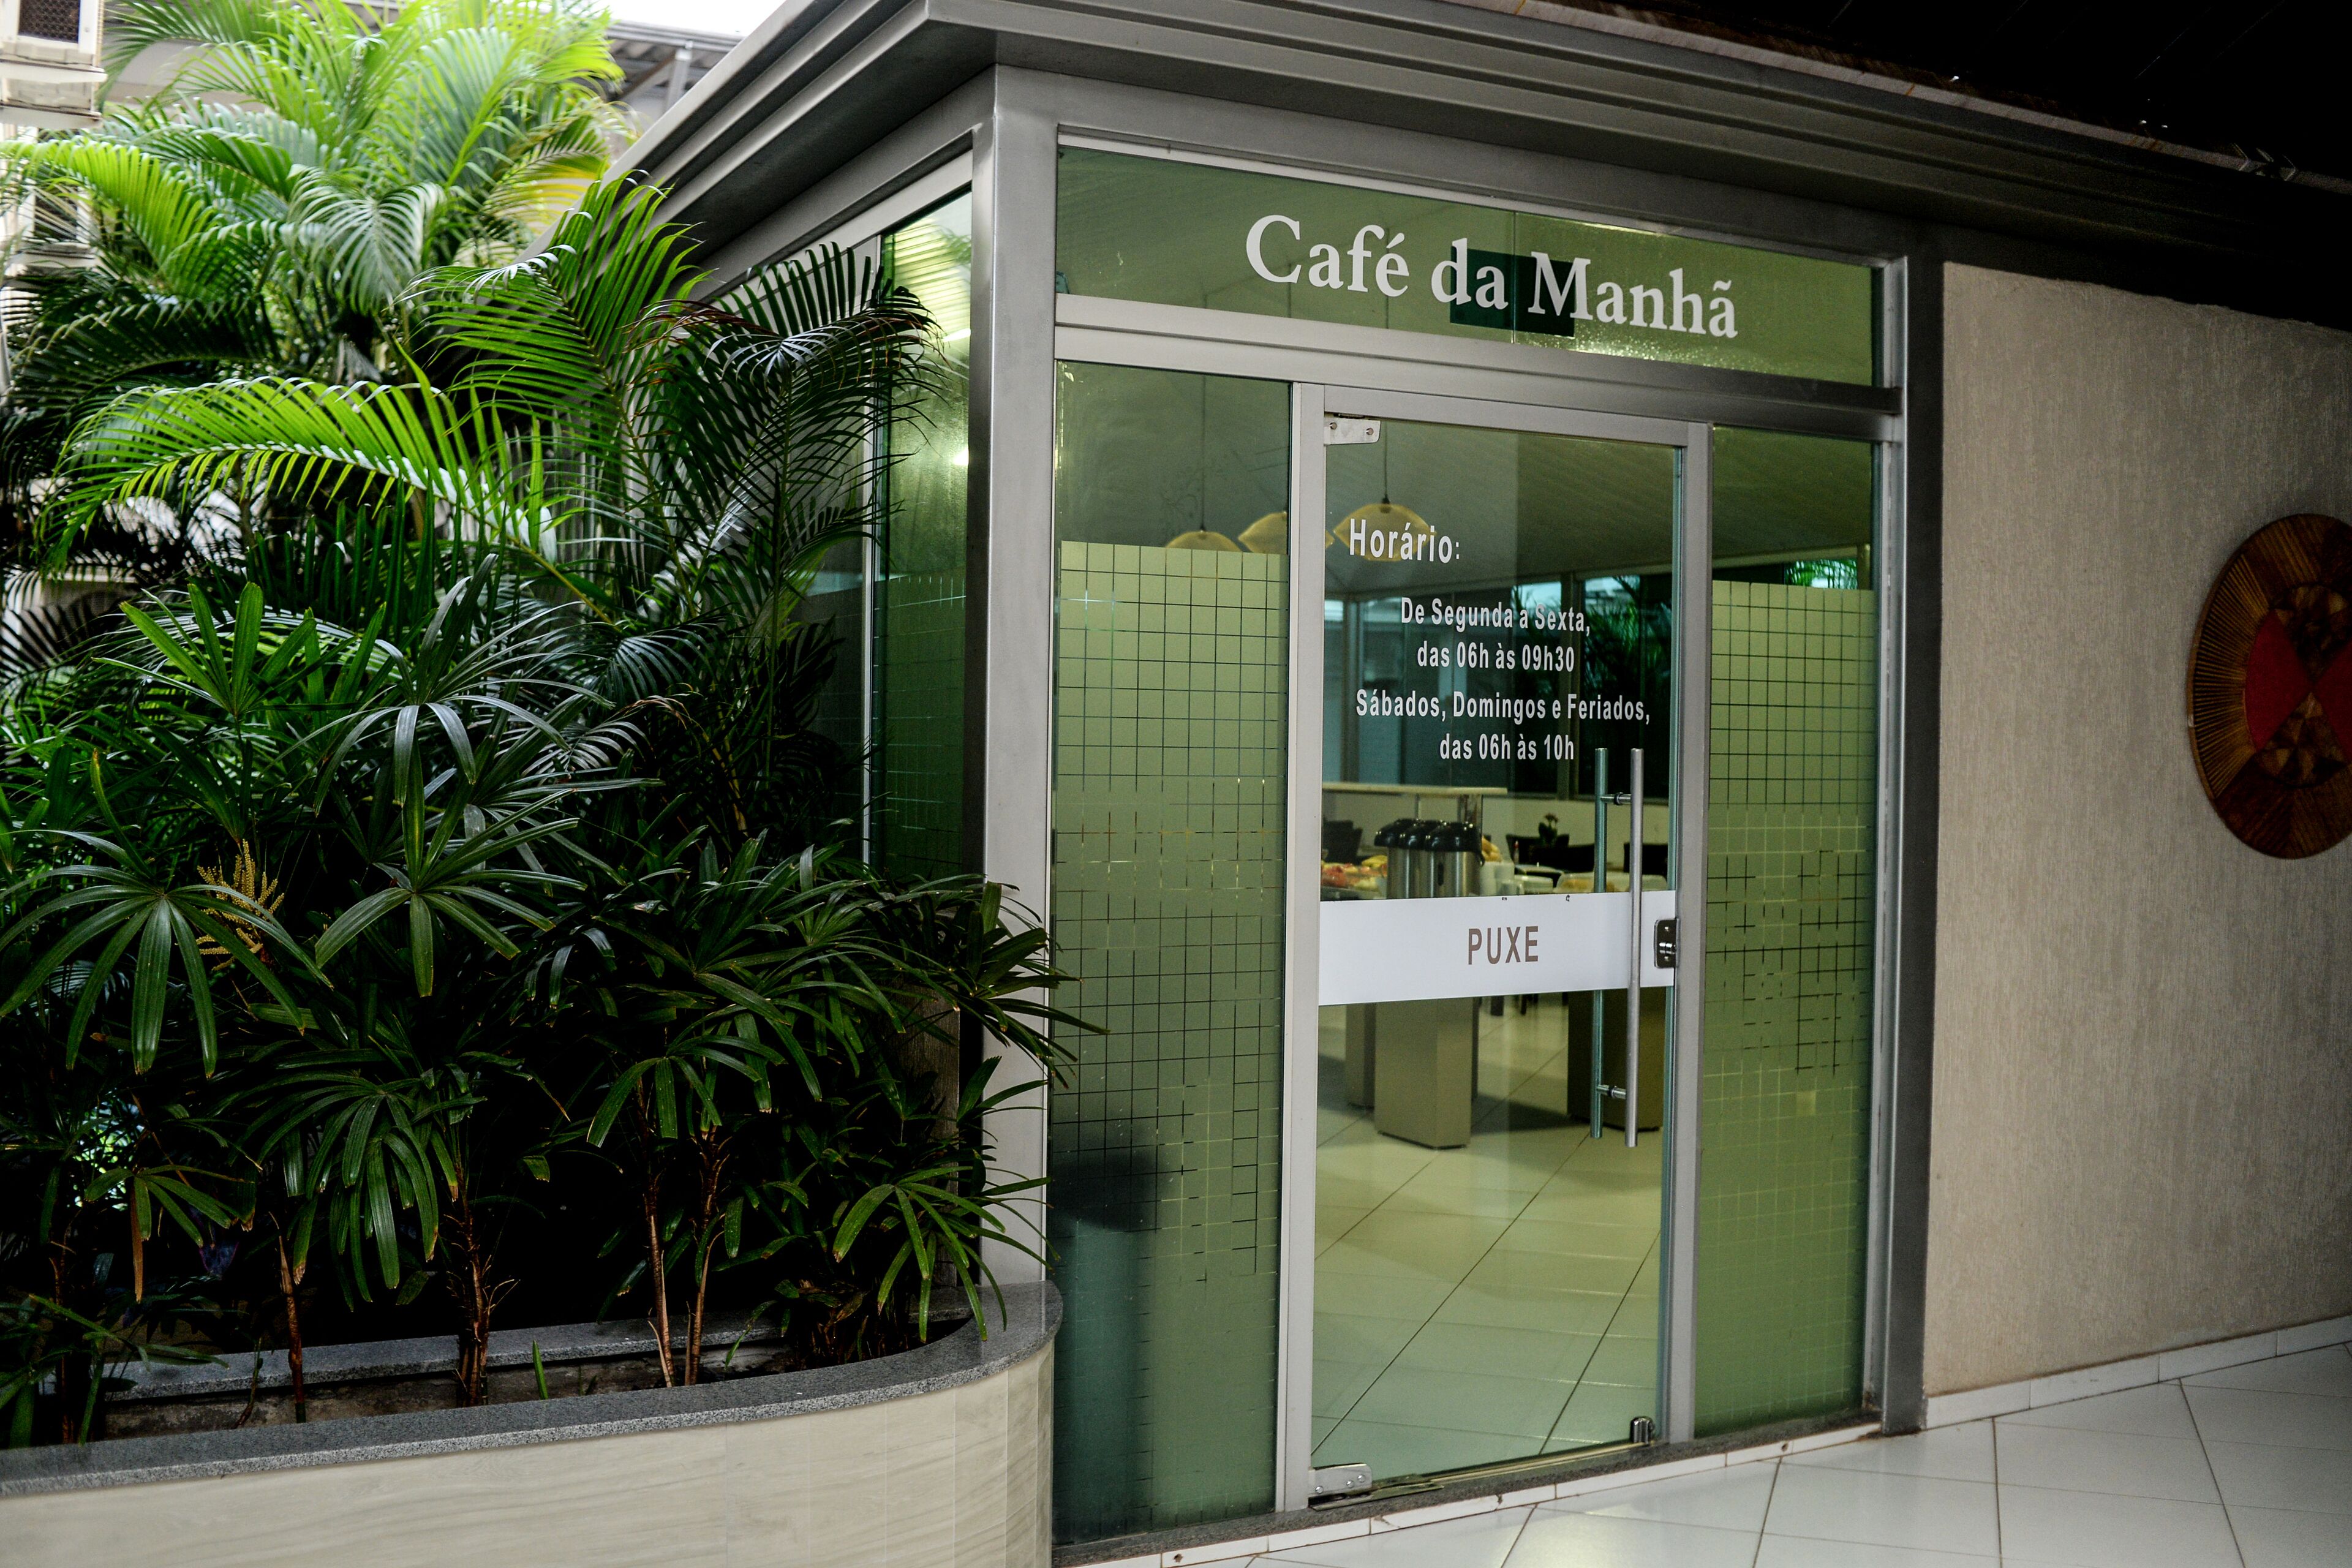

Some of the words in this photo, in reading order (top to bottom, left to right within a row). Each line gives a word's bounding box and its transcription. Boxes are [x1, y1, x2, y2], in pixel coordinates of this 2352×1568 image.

[1246, 214, 1409, 297] Café
[1431, 238, 1508, 309] da
[1528, 251, 1738, 338] Manhã
[1349, 518, 1460, 564] Horário:
[1401, 597, 1425, 624] De
[1431, 598, 1513, 633] Segunda
[1520, 608, 1529, 629] a
[1535, 603, 1590, 636] Sexta,
[1417, 640, 1450, 667] das
[1457, 641, 1488, 668] 06h
[1496, 643, 1515, 669] às
[1522, 644, 1575, 672] 09h30
[1356, 688, 1446, 722] Sábados,
[1453, 691, 1546, 725] Domingos
[1552, 698, 1561, 719] e
[1567, 693, 1650, 725] Feriados,
[1440, 733, 1472, 760] das
[1479, 733, 1510, 760] 06h
[1517, 734, 1537, 760] às
[1544, 734, 1574, 760] 10h
[1468, 925, 1539, 965] PUXE
